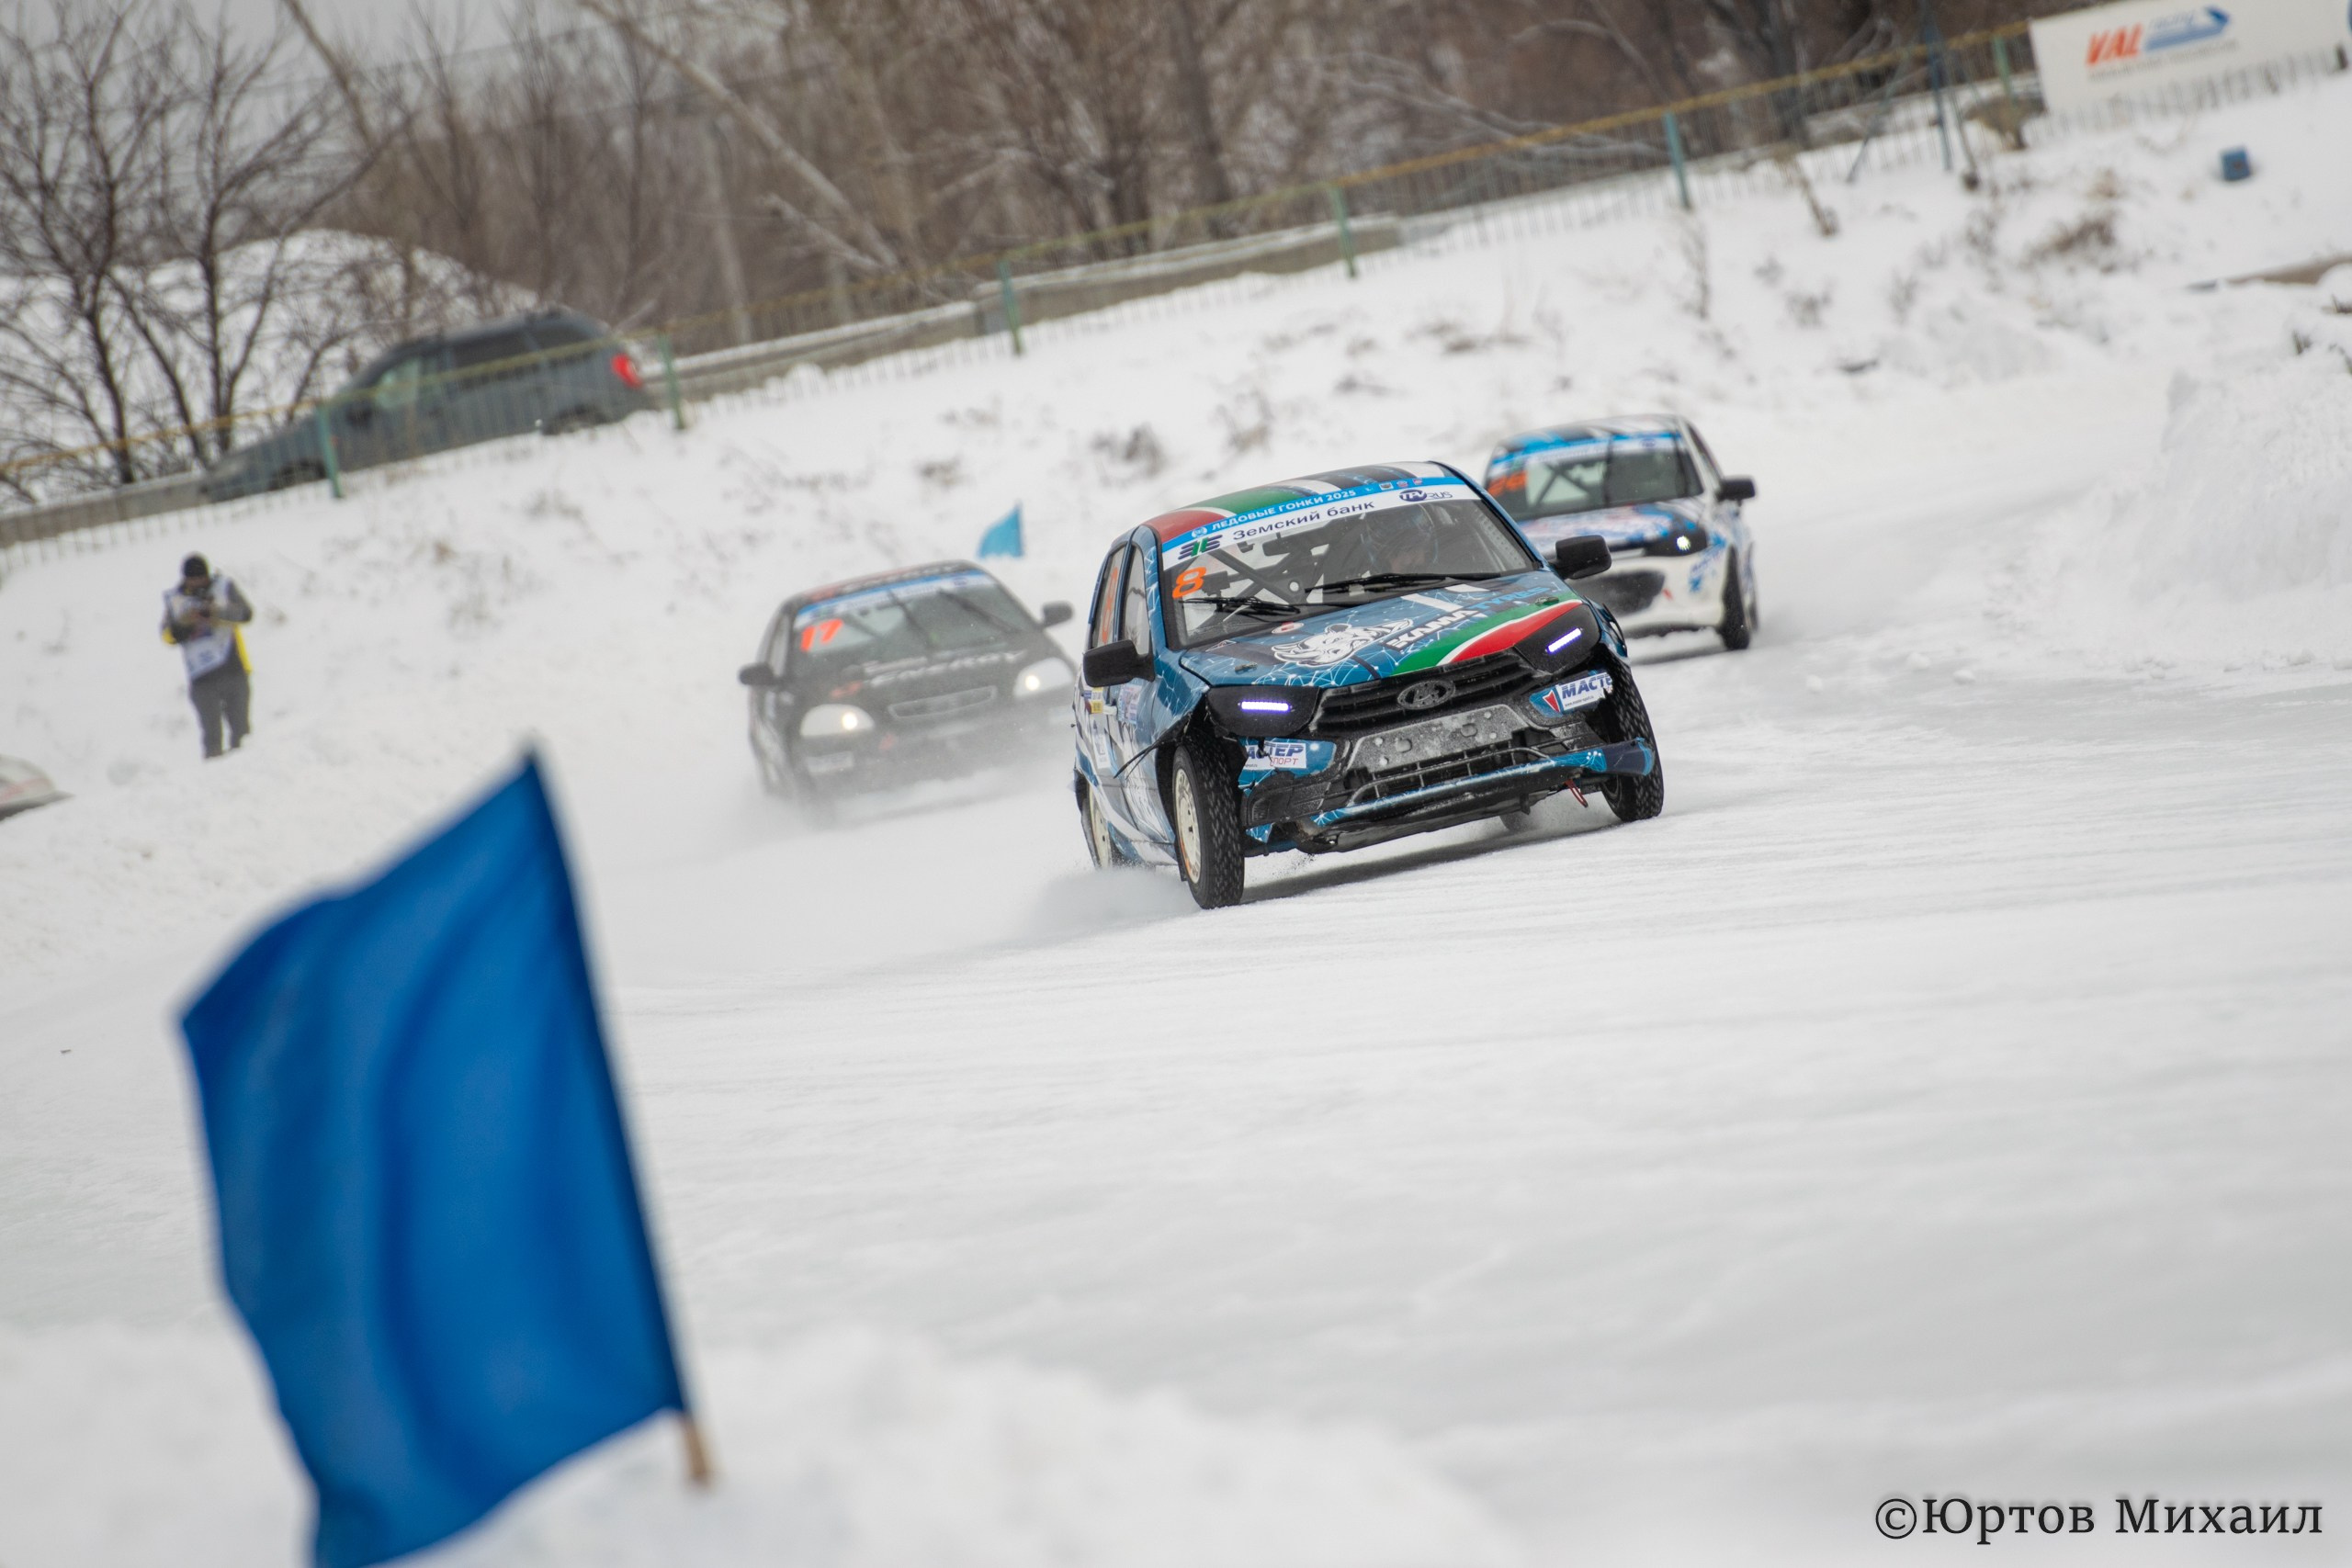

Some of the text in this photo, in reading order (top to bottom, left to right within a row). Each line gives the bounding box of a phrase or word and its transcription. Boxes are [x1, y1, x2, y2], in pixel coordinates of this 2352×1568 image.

[2086, 23, 2143, 66] VAL
[1212, 490, 1356, 531] ЛЕДОВЫЕ ГОНКИ 2025
[1399, 491, 1427, 502] TPV
[1232, 501, 1375, 540] Земский банк
[1172, 566, 1206, 600] 8
[1386, 609, 1479, 649] KAMA
